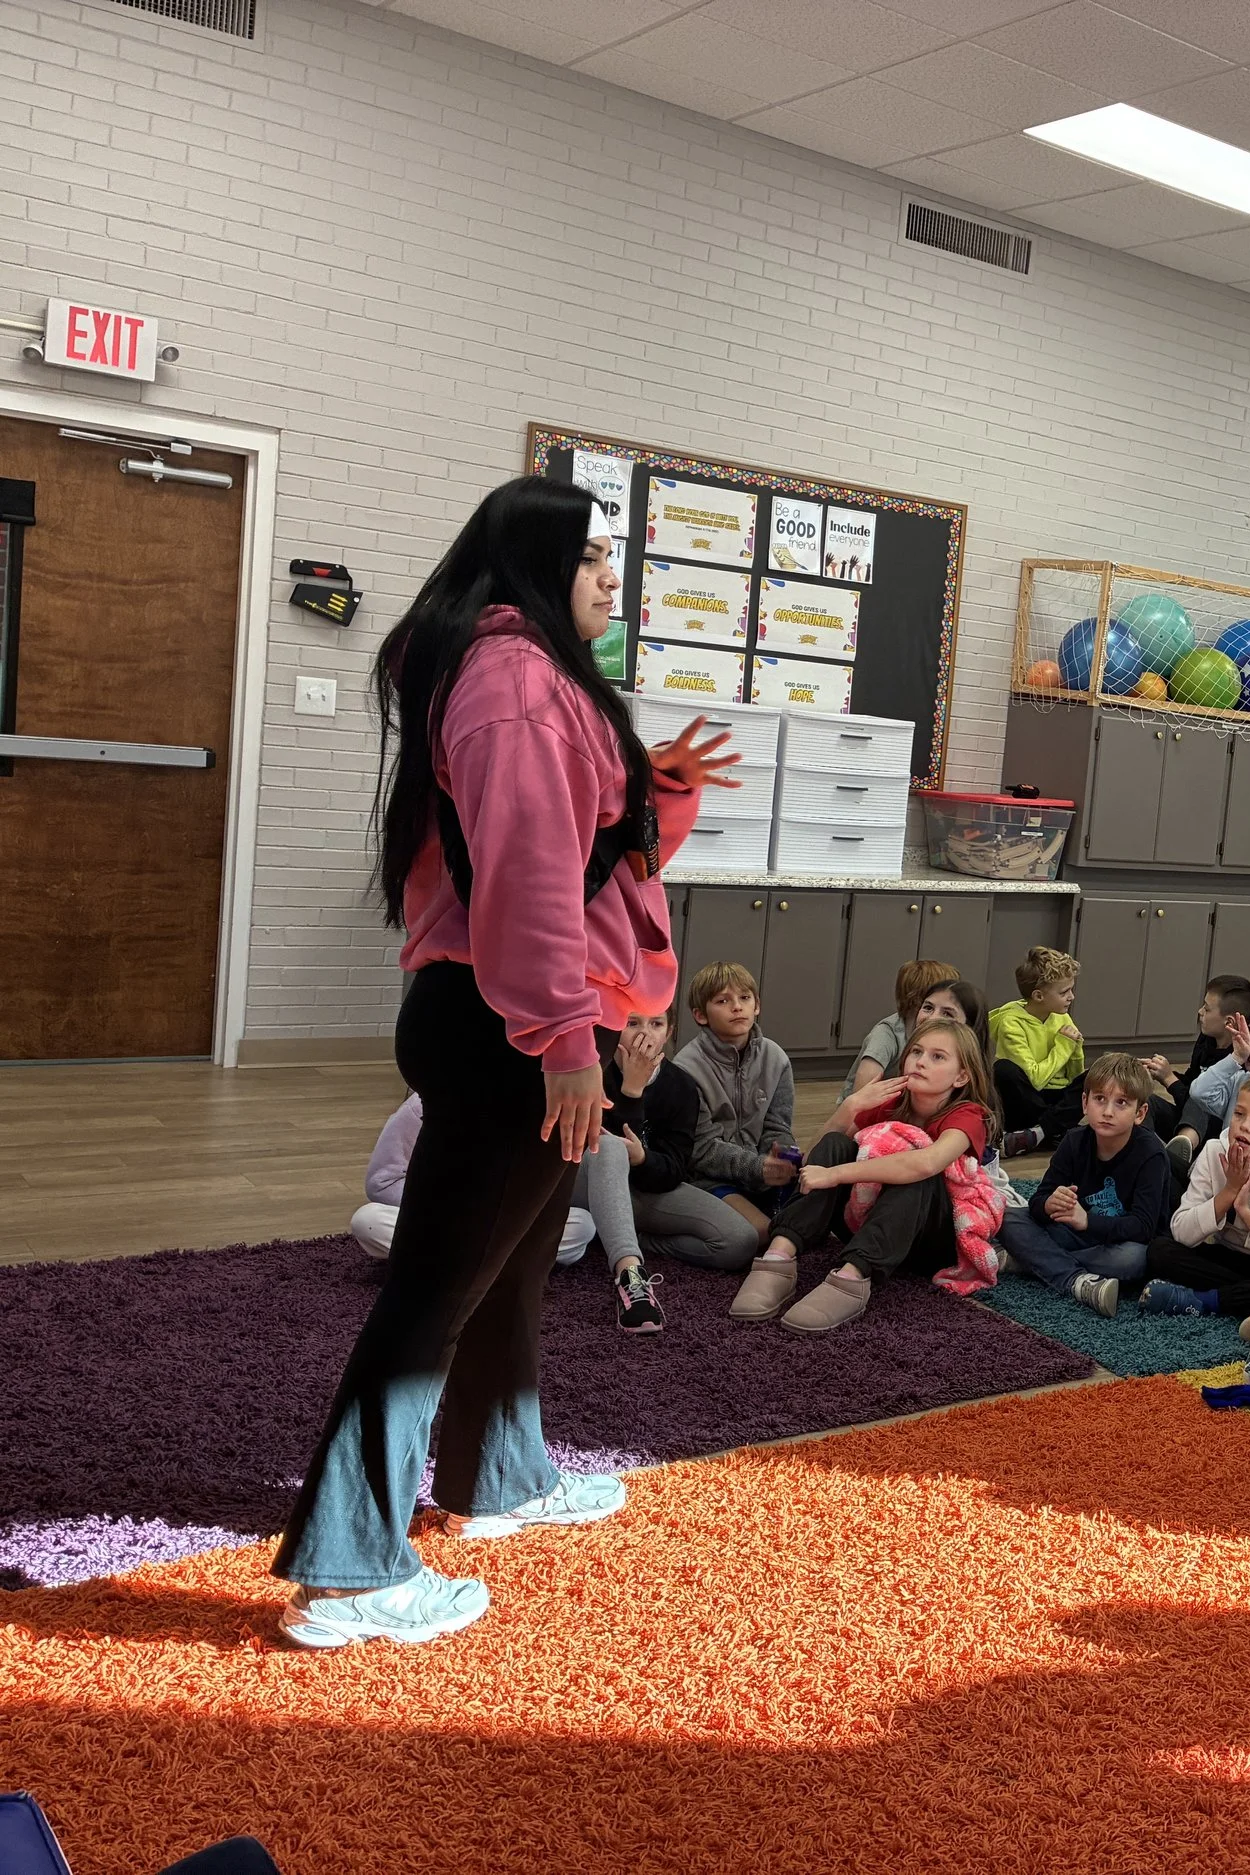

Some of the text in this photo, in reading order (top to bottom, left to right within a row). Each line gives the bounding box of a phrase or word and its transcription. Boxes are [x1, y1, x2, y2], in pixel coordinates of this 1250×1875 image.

[66, 305, 144, 371] EXIT
[577, 456, 618, 475] Speak
[775, 502, 801, 519] Be a
[776, 518, 816, 539] GOOD
[830, 520, 871, 537] Include
[829, 534, 870, 548] everyone
[690, 589, 707, 597] GIVES
[662, 594, 730, 615] COMPANIONS.
[804, 605, 819, 613] GIVES
[773, 608, 844, 630] OPPORTUNITIES.
[664, 674, 717, 693] BOLDNESS.
[796, 682, 812, 690] GIVES
[789, 689, 815, 703] HOPE.
